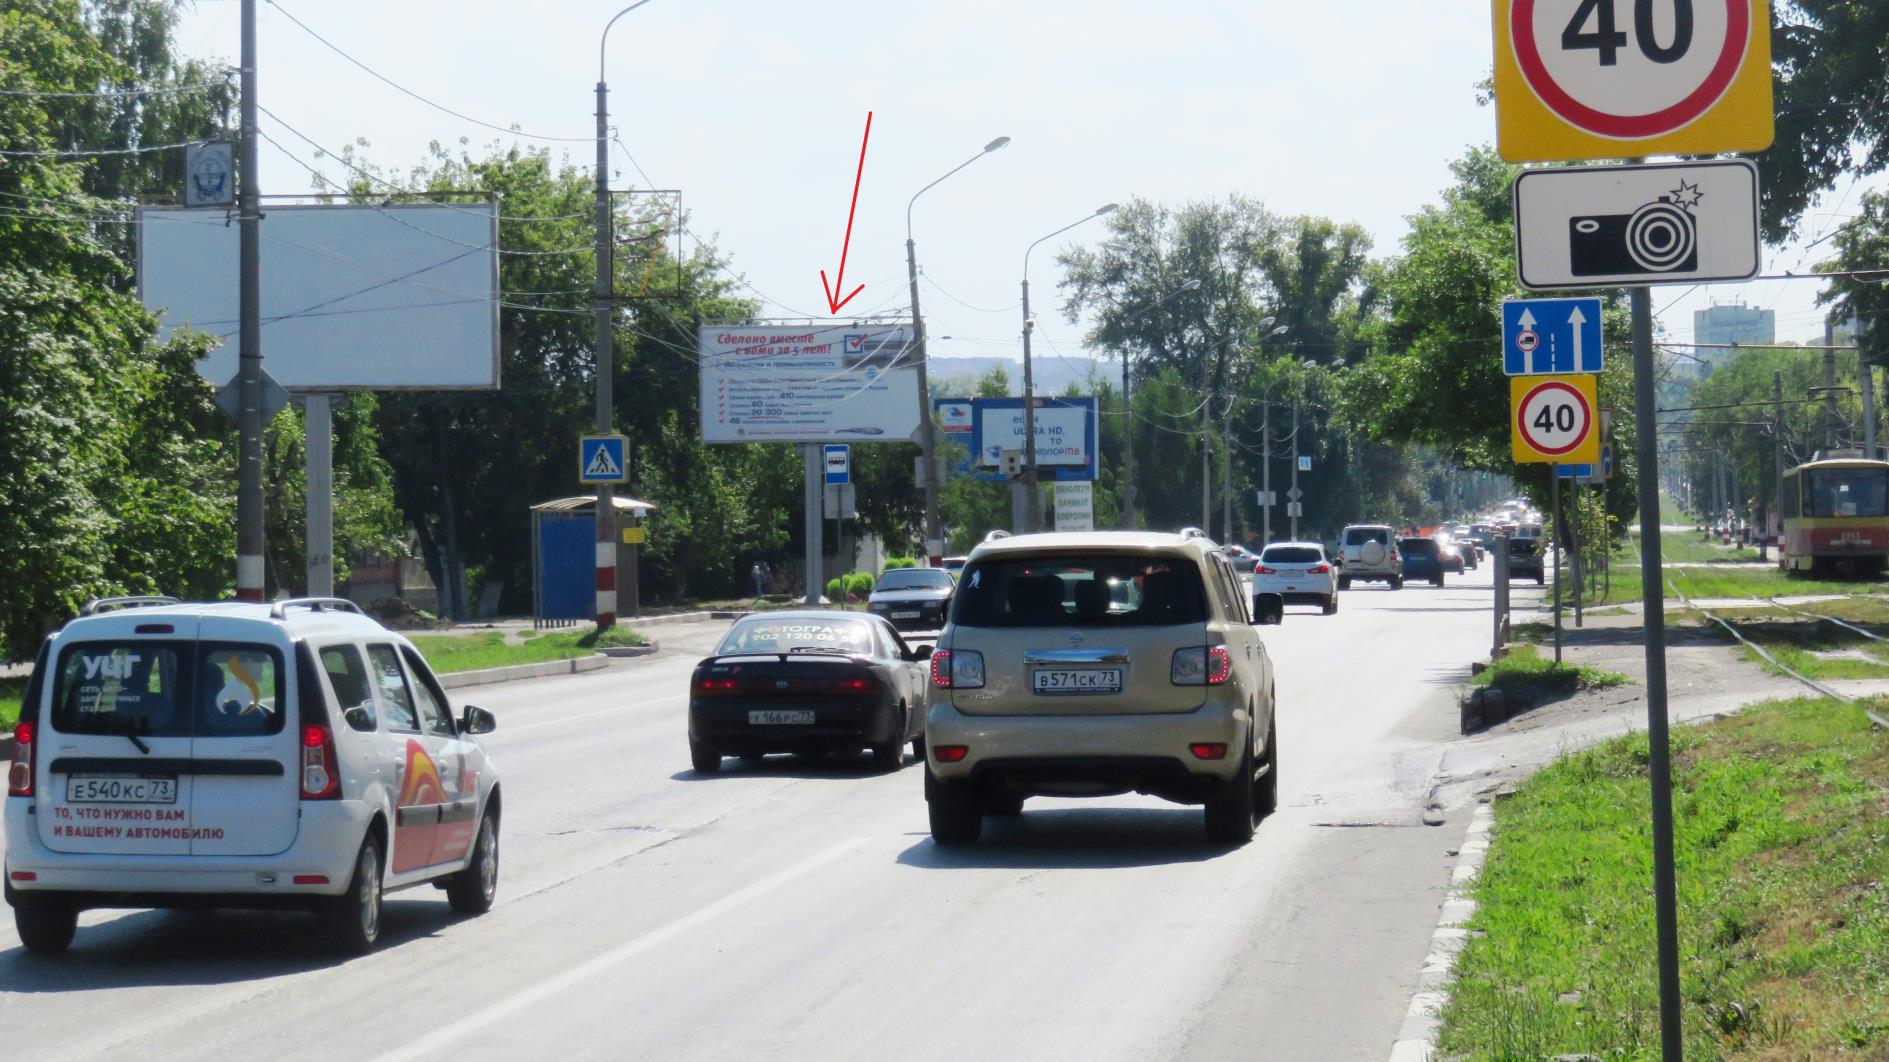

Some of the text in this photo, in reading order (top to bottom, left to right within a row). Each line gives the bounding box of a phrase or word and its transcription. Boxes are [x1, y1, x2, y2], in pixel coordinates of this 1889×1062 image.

[1561, 0, 1694, 66] 40
[1533, 404, 1575, 433] 40
[1013, 426, 1045, 435] ULRA
[1040, 671, 1115, 687] В571СК 73
[74, 781, 169, 798] Е540КС 73
[54, 807, 185, 822] ТО, ЧТО НУЖНО ВАМ
[54, 826, 225, 840] И ВАШЕМУ АВТОМОБИЛЮ
